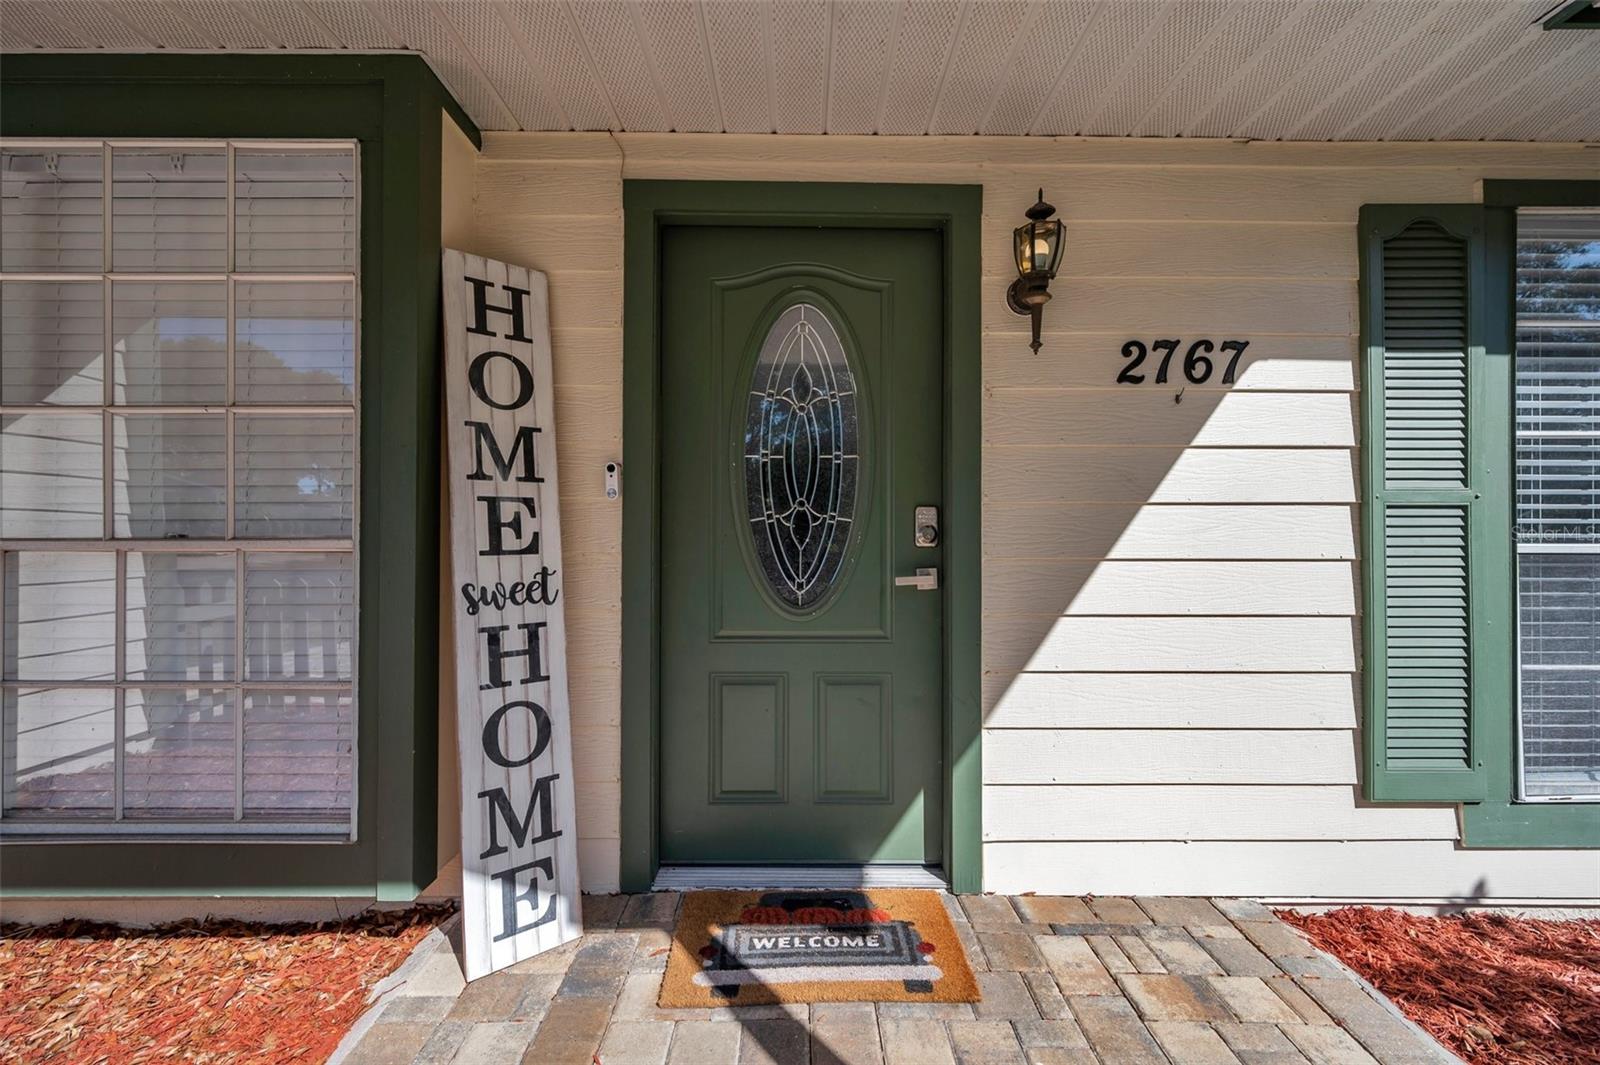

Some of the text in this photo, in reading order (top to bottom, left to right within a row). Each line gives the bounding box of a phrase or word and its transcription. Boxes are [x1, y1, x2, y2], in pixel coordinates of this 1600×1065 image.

[1116, 339, 1250, 385] 2767
[463, 275, 545, 556] HOME
[461, 566, 560, 616] sweet
[477, 621, 563, 942] HOME
[752, 934, 881, 951] WELCOME
